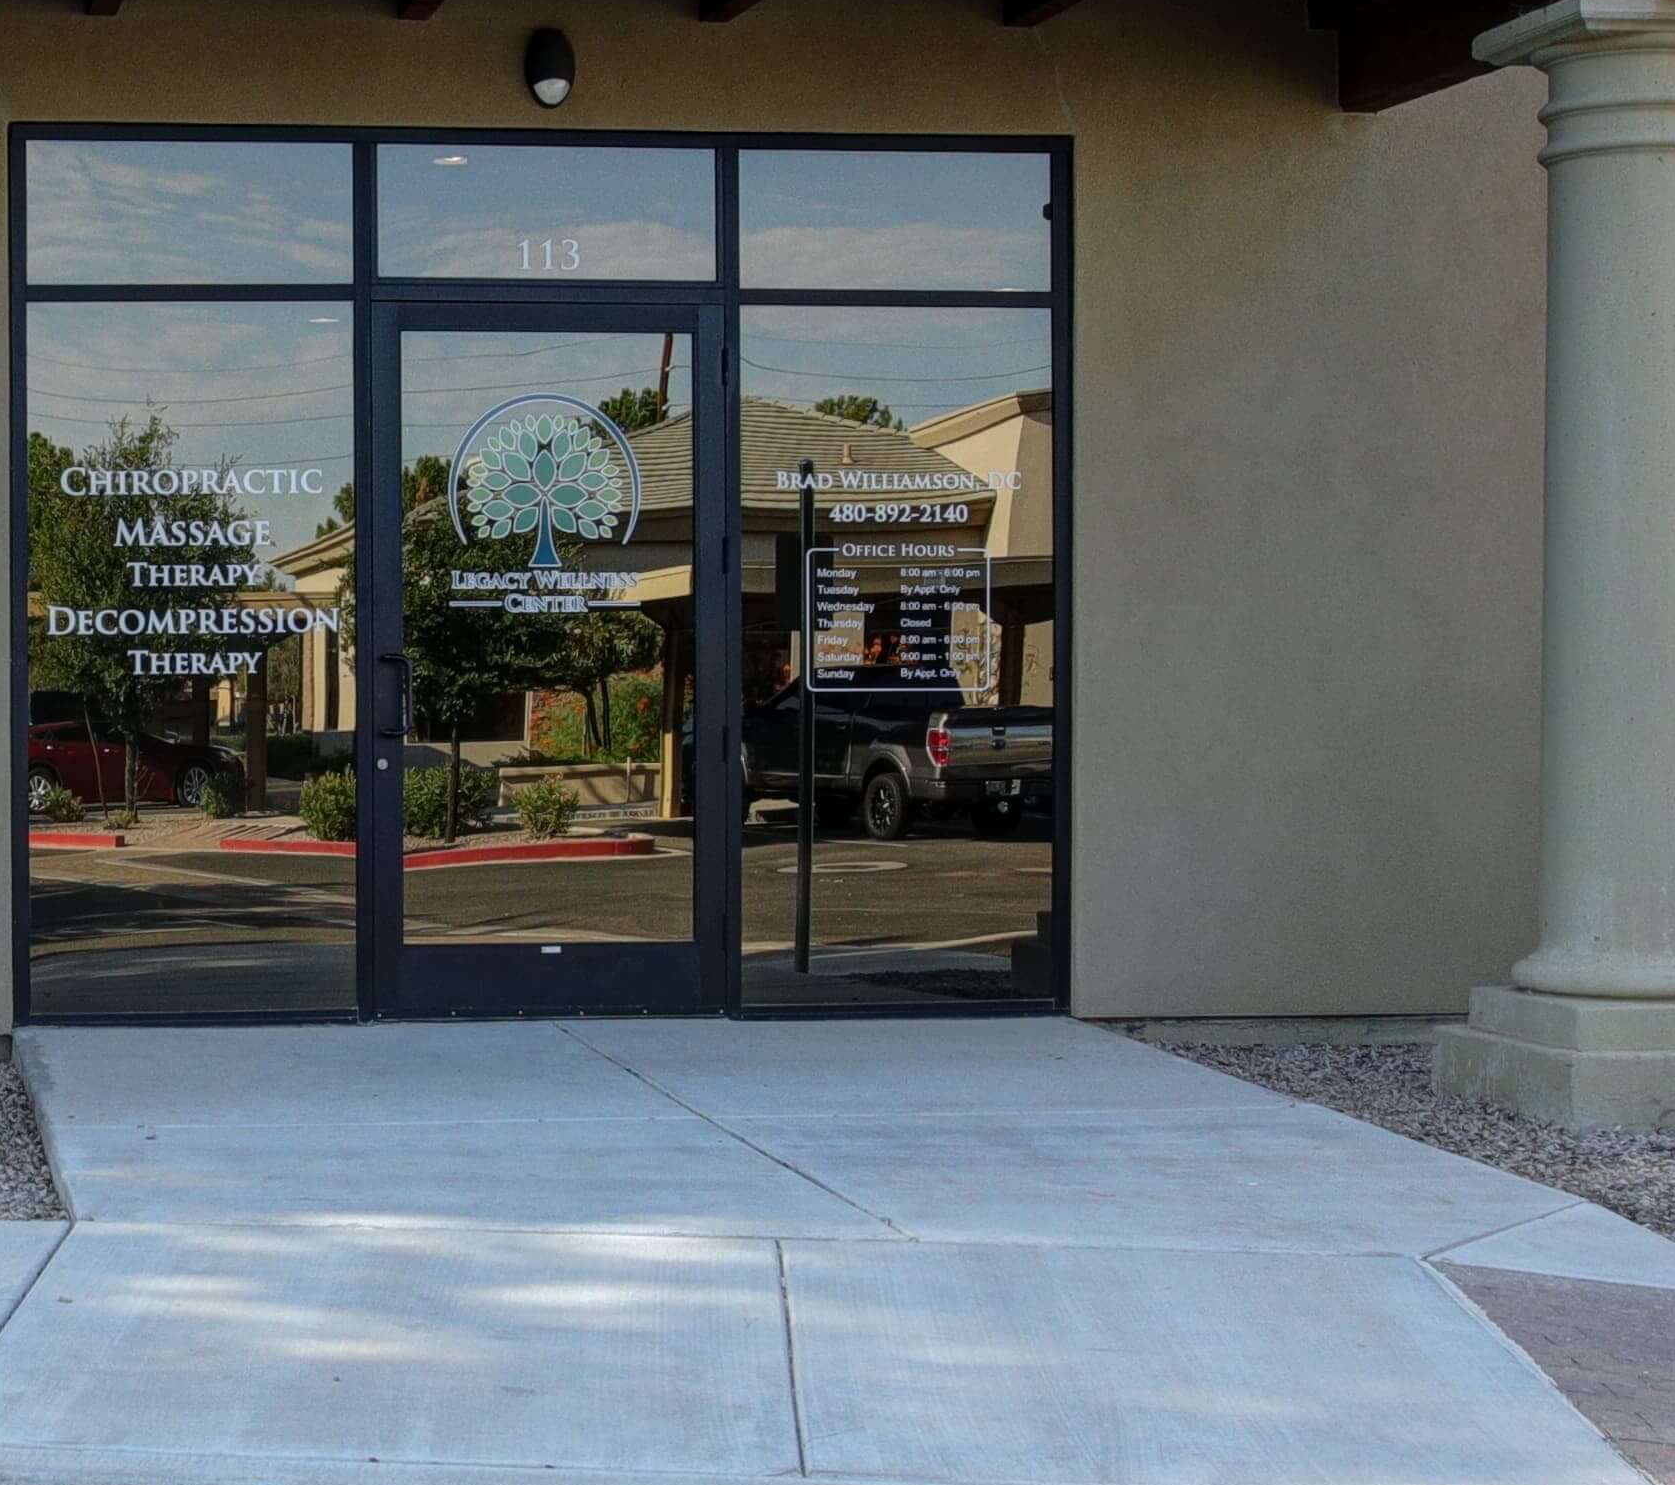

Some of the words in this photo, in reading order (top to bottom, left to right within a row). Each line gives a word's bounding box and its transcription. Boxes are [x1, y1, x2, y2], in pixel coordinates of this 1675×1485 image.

[517, 238, 581, 271] 113
[60, 466, 323, 496] CHIROPRACTIC
[776, 470, 833, 490] BRAD
[838, 470, 982, 492] WILLIAMSON,
[988, 471, 1022, 490] DC
[828, 504, 968, 523] 480-892-2140
[114, 518, 271, 547] MASSAGE
[842, 543, 896, 557] OFFICE
[901, 544, 955, 557] HOURS
[127, 562, 260, 587] THERAPY
[451, 570, 532, 590] LEGACY
[533, 569, 639, 590] WELLNESS
[817, 568, 857, 580] Monday
[966, 570, 980, 580] pm
[817, 585, 860, 597] Tuesday
[900, 585, 913, 596] By
[914, 585, 937, 596] Appt.
[939, 585, 960, 596] Only
[504, 593, 589, 613] CENTER
[817, 602, 875, 613] Wednesday
[966, 604, 980, 614] pm
[47, 605, 340, 636] DECOMPRESSION
[817, 618, 863, 630] Thursday
[900, 618, 931, 627] Closed
[817, 635, 849, 647] Friday
[966, 637, 980, 647] pm
[127, 649, 262, 675] THERAPY
[817, 652, 862, 663] Saturday
[966, 654, 980, 664] pm
[817, 669, 855, 680] Sunday
[900, 669, 913, 680] By
[914, 669, 937, 680] Appt.
[939, 669, 960, 680] Only
